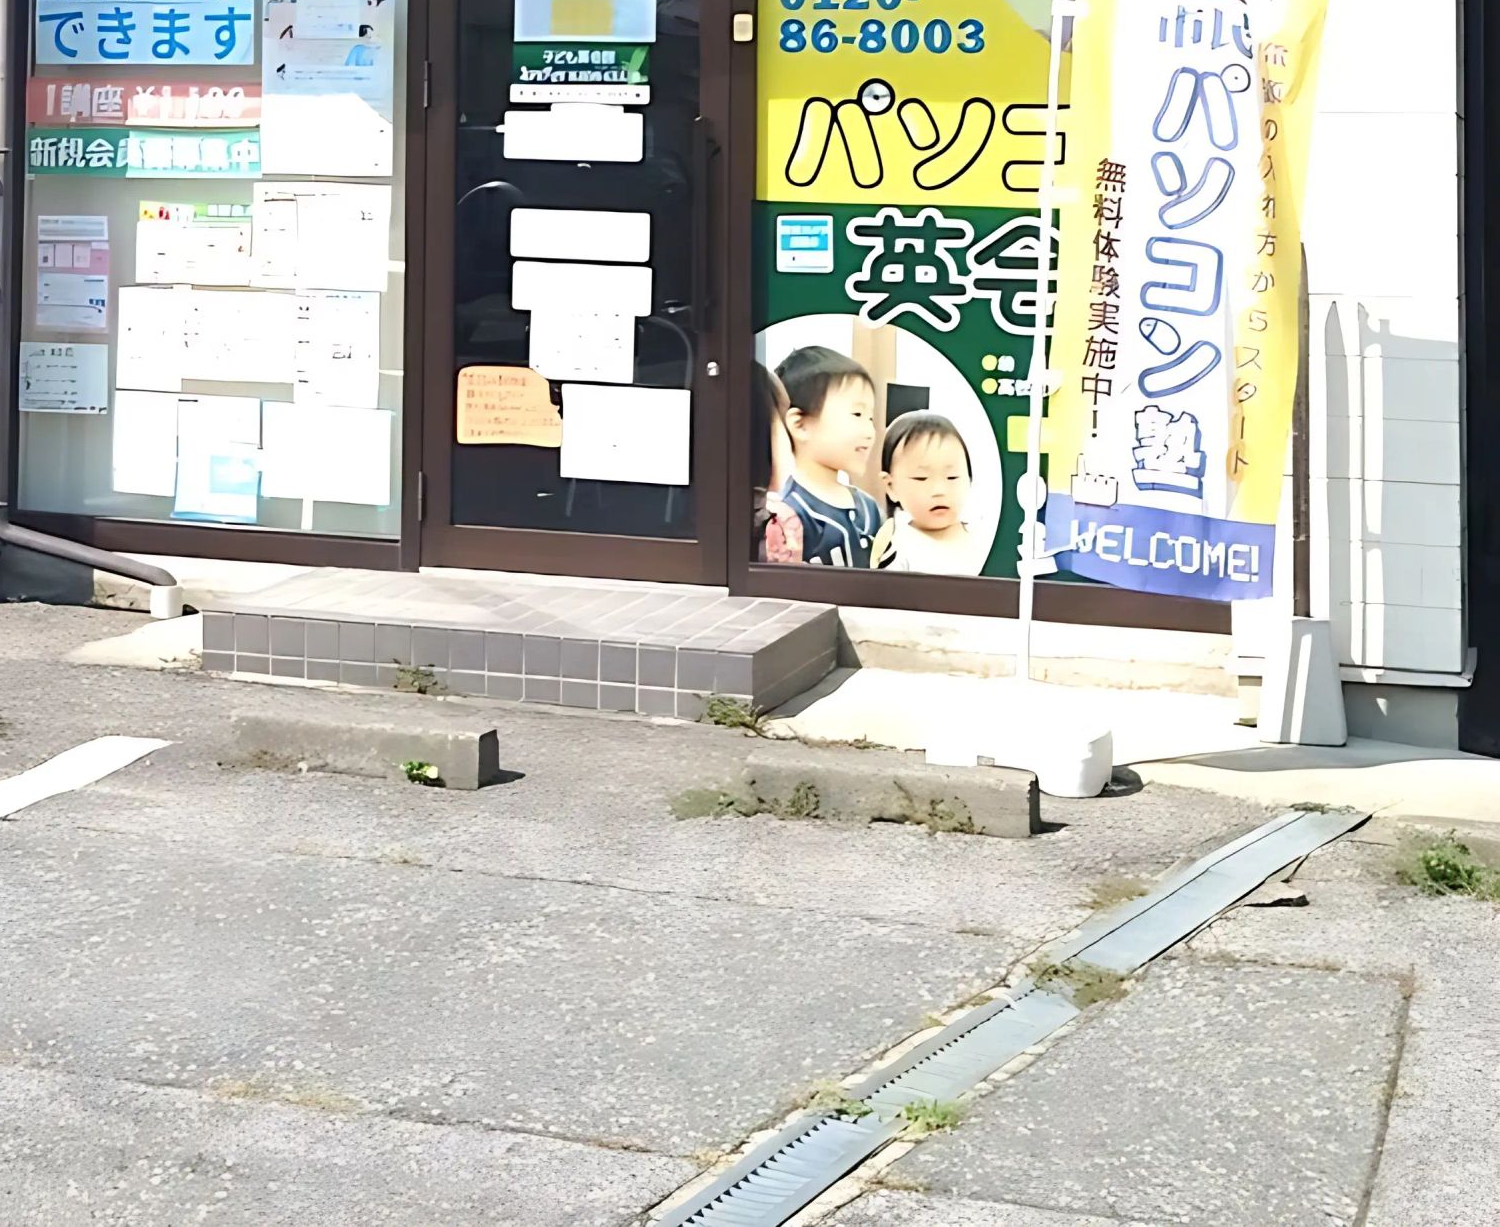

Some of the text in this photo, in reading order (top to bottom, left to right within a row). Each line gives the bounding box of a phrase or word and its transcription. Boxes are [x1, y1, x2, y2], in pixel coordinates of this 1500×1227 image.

[38, 7, 252, 60] できます
[778, 18, 986, 55] 86-8003
[1069, 518, 1260, 583] WELCOME!
